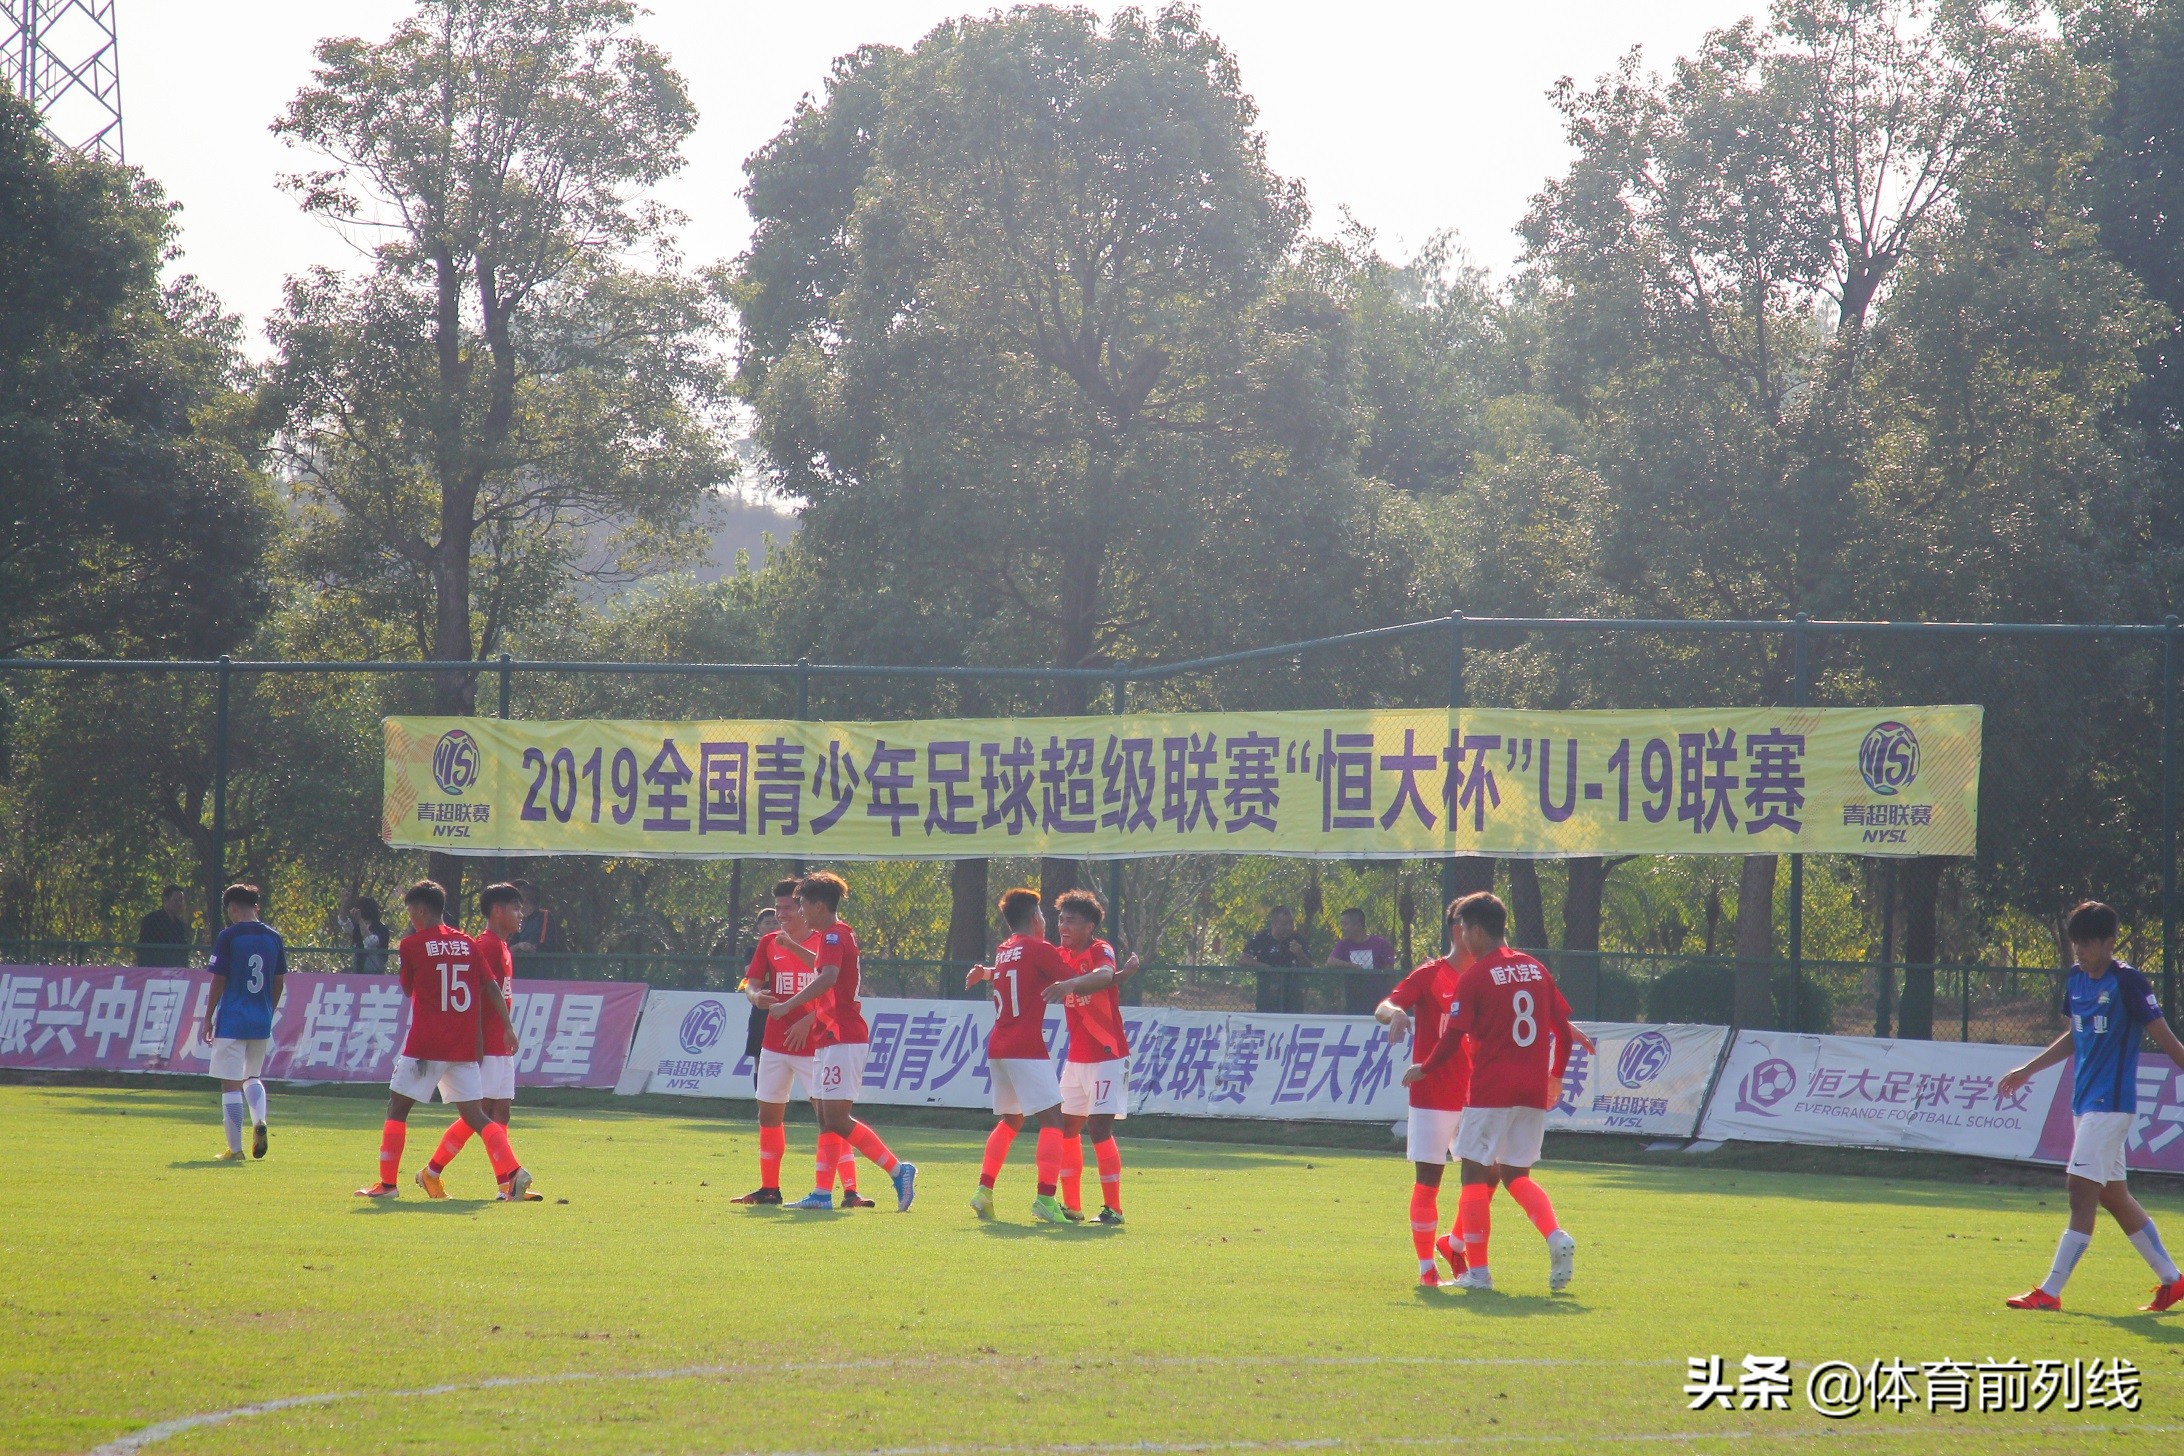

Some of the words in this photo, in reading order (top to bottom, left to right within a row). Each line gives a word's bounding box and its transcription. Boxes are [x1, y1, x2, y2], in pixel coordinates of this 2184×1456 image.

[417, 802, 490, 823] 青超联赛
[1843, 803, 1931, 826] 青超联赛
[433, 825, 470, 837] NYSL
[1862, 829, 1907, 843] NYSL
[425, 940, 470, 957] 恒大汽车
[247, 954, 264, 993] 3
[1490, 964, 1542, 985] 恒大汽车
[436, 963, 471, 1012] 15
[1512, 990, 1537, 1047] 8
[657, 1060, 724, 1078] 青超联赛
[823, 1066, 841, 1085] 23
[666, 1079, 701, 1089] NYSL
[1094, 1080, 1111, 1100] 17
[1592, 1094, 1668, 1117] 青超联赛
[1604, 1116, 1643, 1128] NYSL
[1794, 1102, 1887, 1120] EVERGRANDE
[1887, 1109, 1962, 1126] FOOTBALL
[1966, 1115, 2022, 1130] SCHOOL
